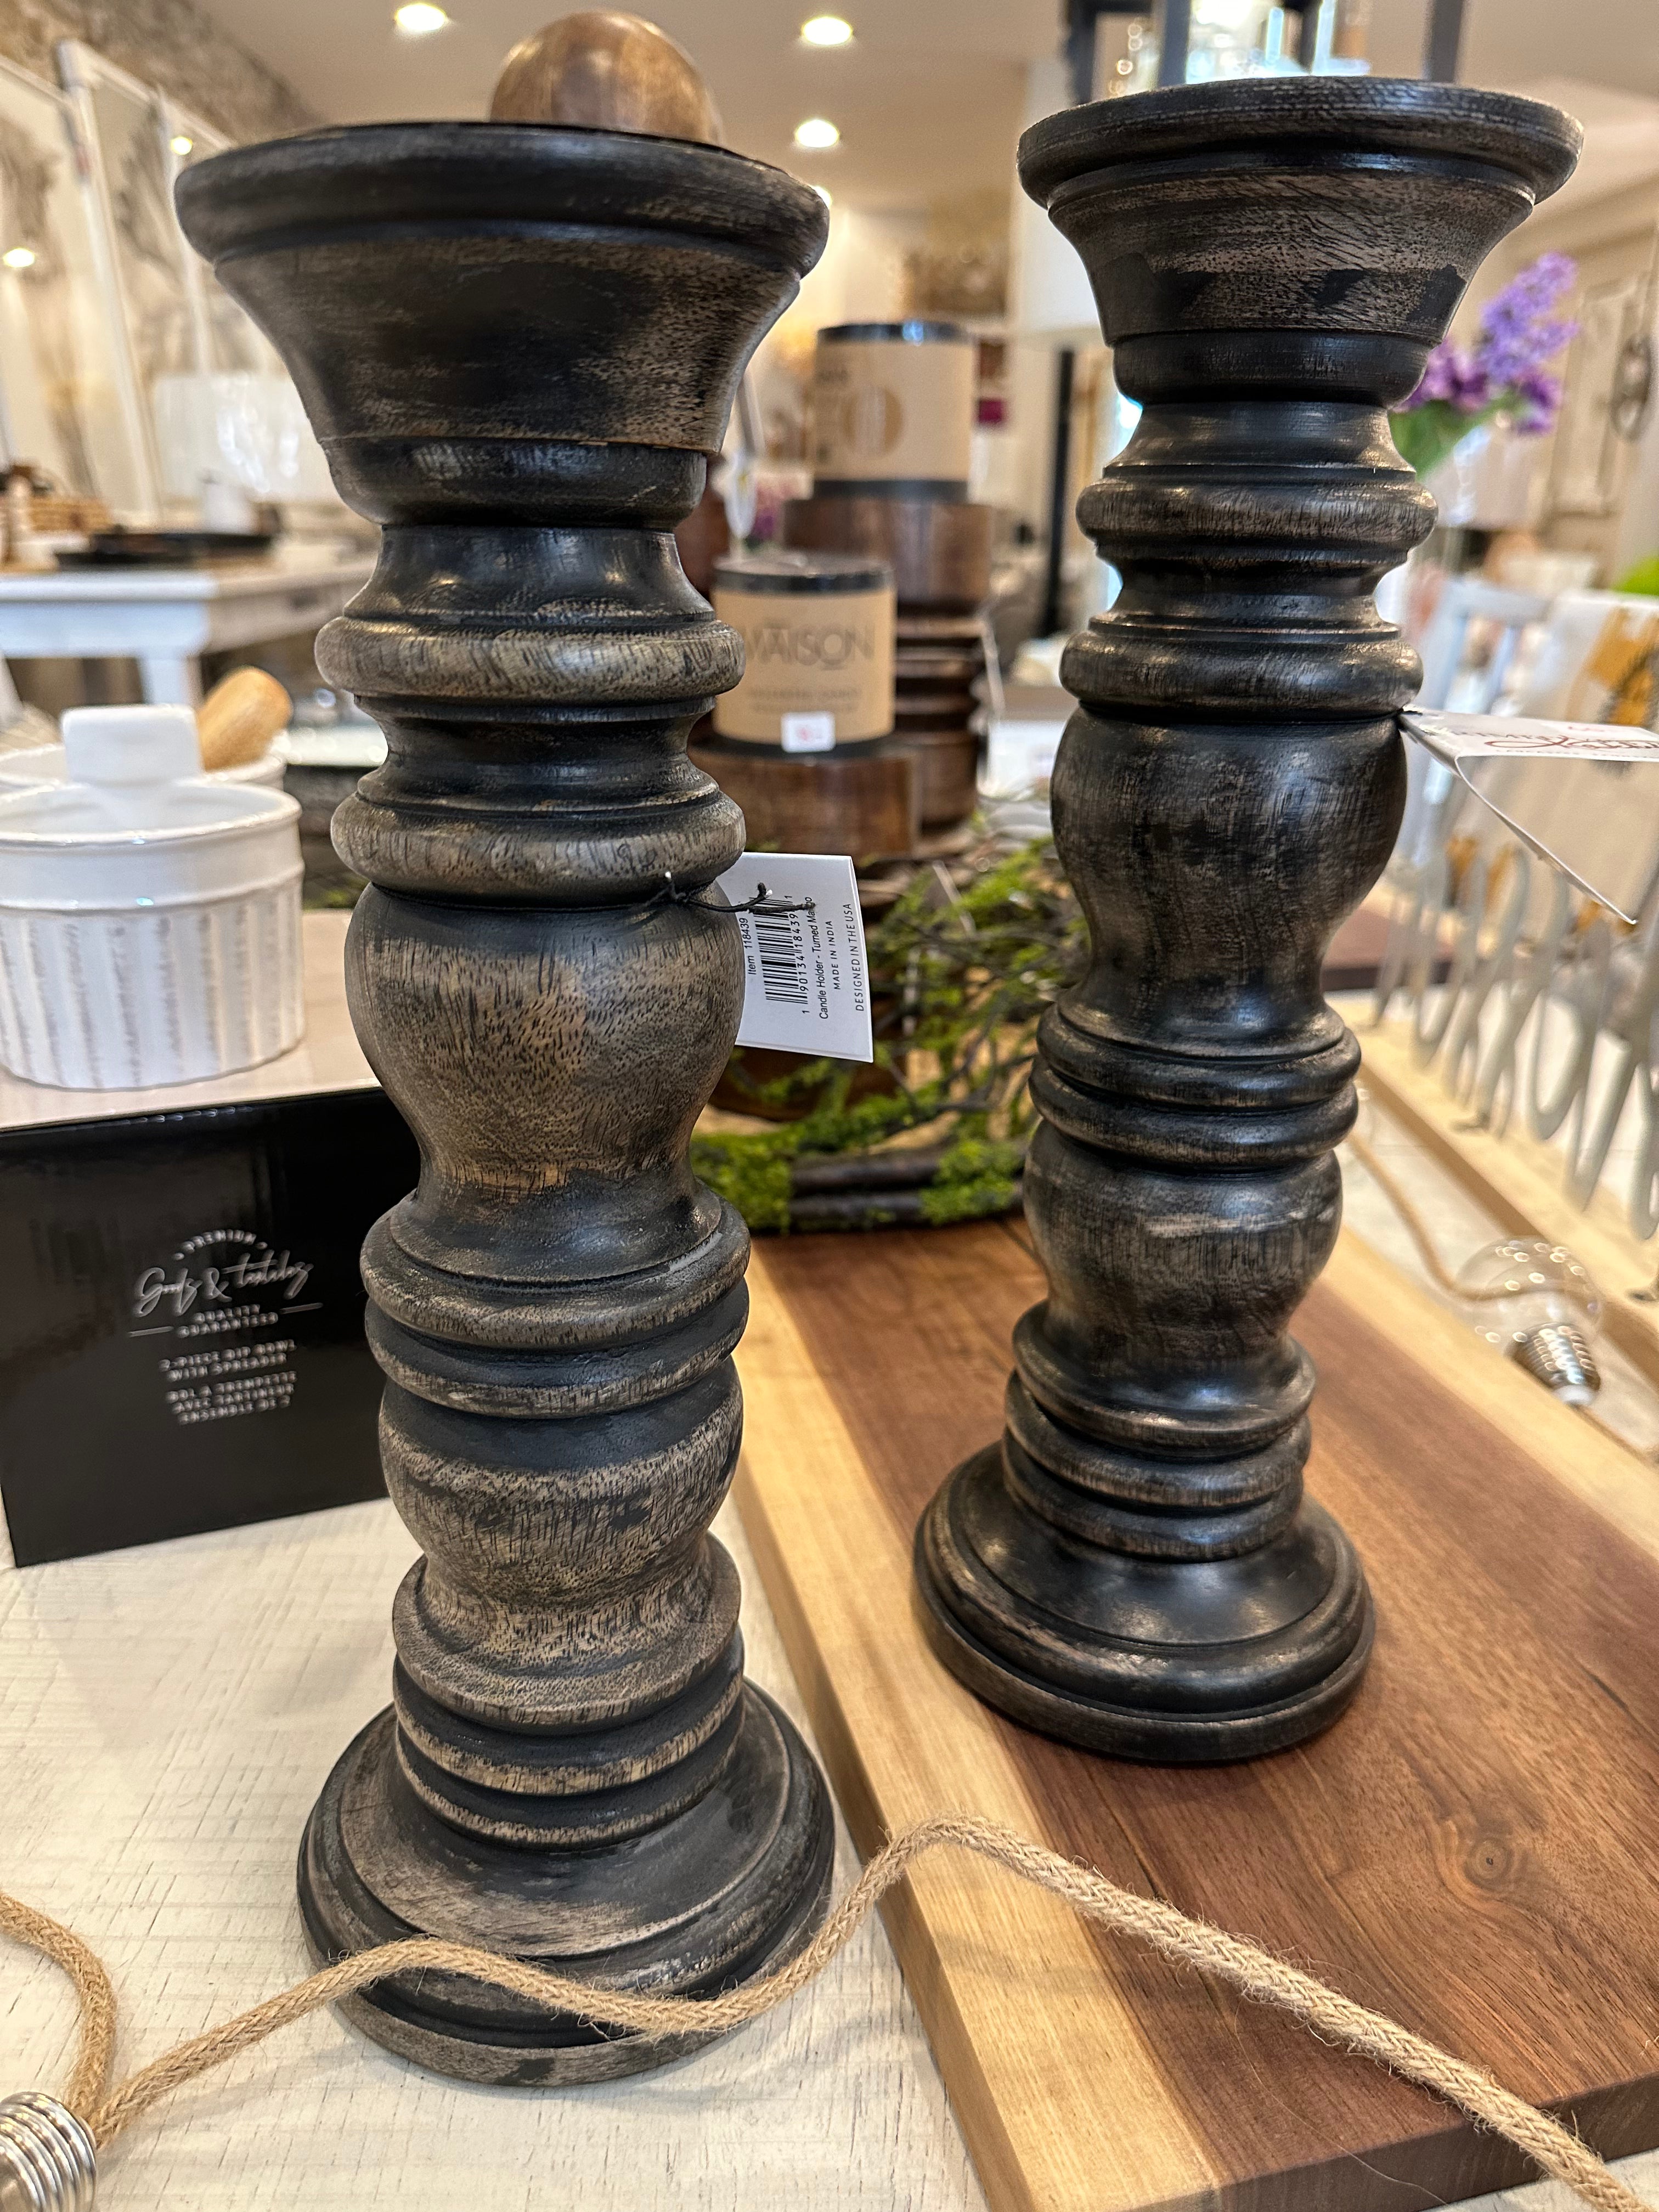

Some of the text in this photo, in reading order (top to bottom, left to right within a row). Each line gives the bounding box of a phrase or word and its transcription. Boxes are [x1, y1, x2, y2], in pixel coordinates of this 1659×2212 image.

[804, 896, 817, 923] Mao
[739, 918, 757, 975] Item 118439
[825, 921, 841, 990] MADE IN INDIA
[843, 903, 864, 1012] DESIGNED IN THE USA
[815, 961, 826, 988] Holder
[818, 990, 828, 1019] Candle
[201, 1267, 233, 1302] &
[176, 1312, 278, 1338] GUARANTEED
